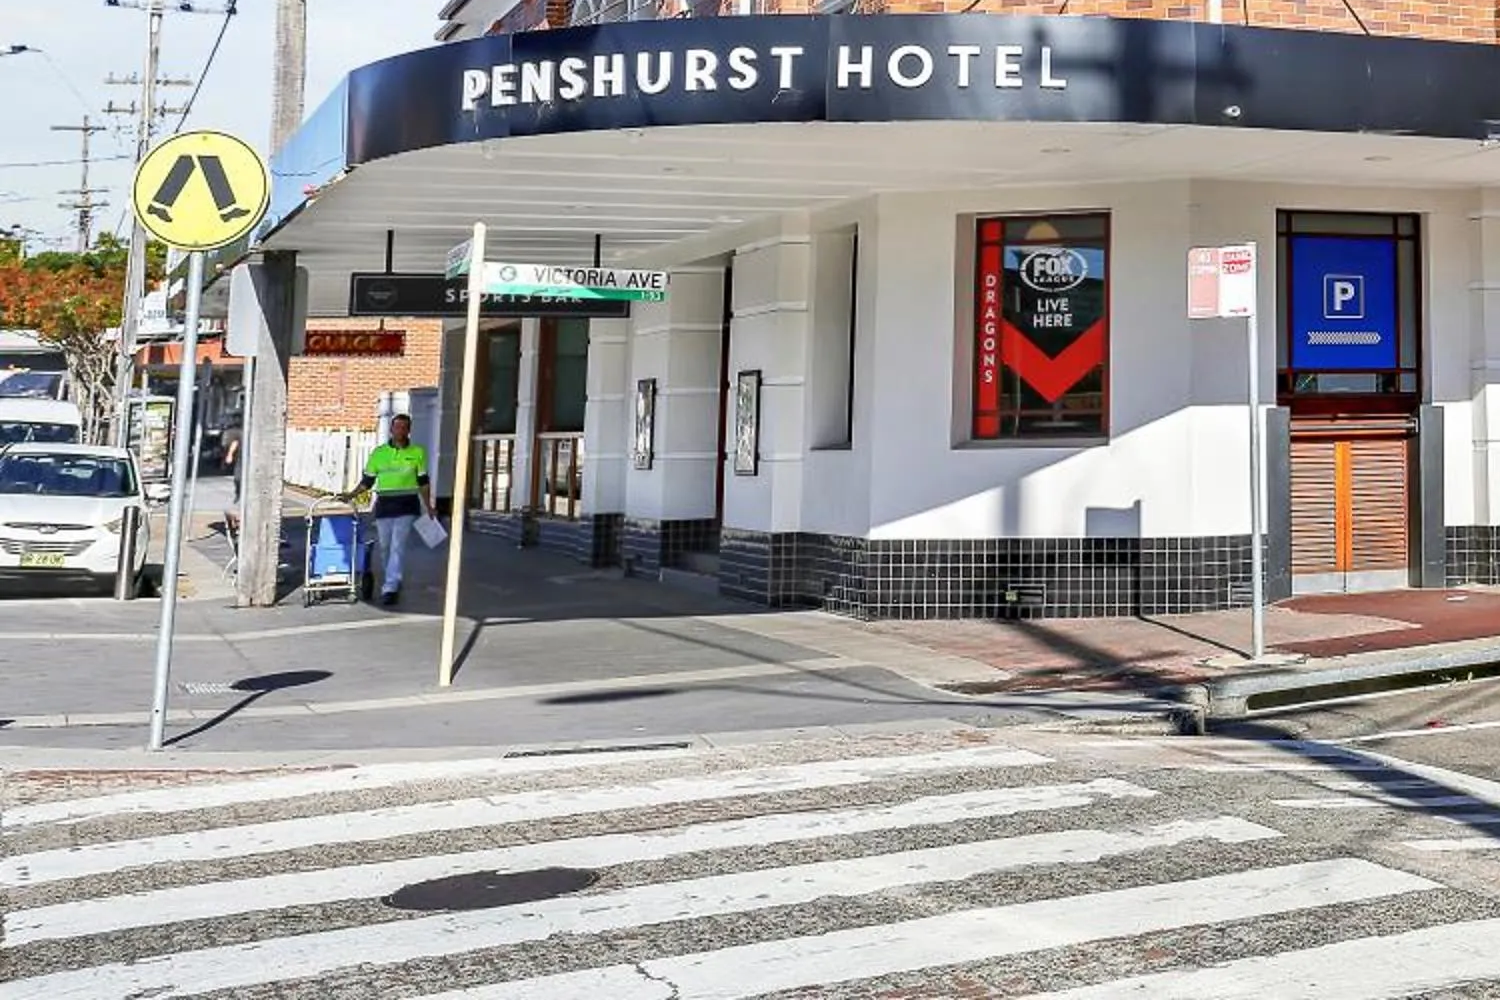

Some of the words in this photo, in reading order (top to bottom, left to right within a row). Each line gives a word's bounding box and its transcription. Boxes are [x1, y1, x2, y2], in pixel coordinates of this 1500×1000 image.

[461, 45, 804, 111] PENSHURST
[836, 45, 1068, 90] HOTEL
[1033, 254, 1074, 277] FOX
[534, 266, 617, 287] VICTORIA
[625, 272, 663, 289] AVE
[1033, 275, 1075, 284] LEAGUE
[1037, 298, 1070, 313] LIVE
[1333, 281, 1356, 312] P
[983, 274, 997, 384] DRAGONS
[1033, 313, 1073, 328] HERE
